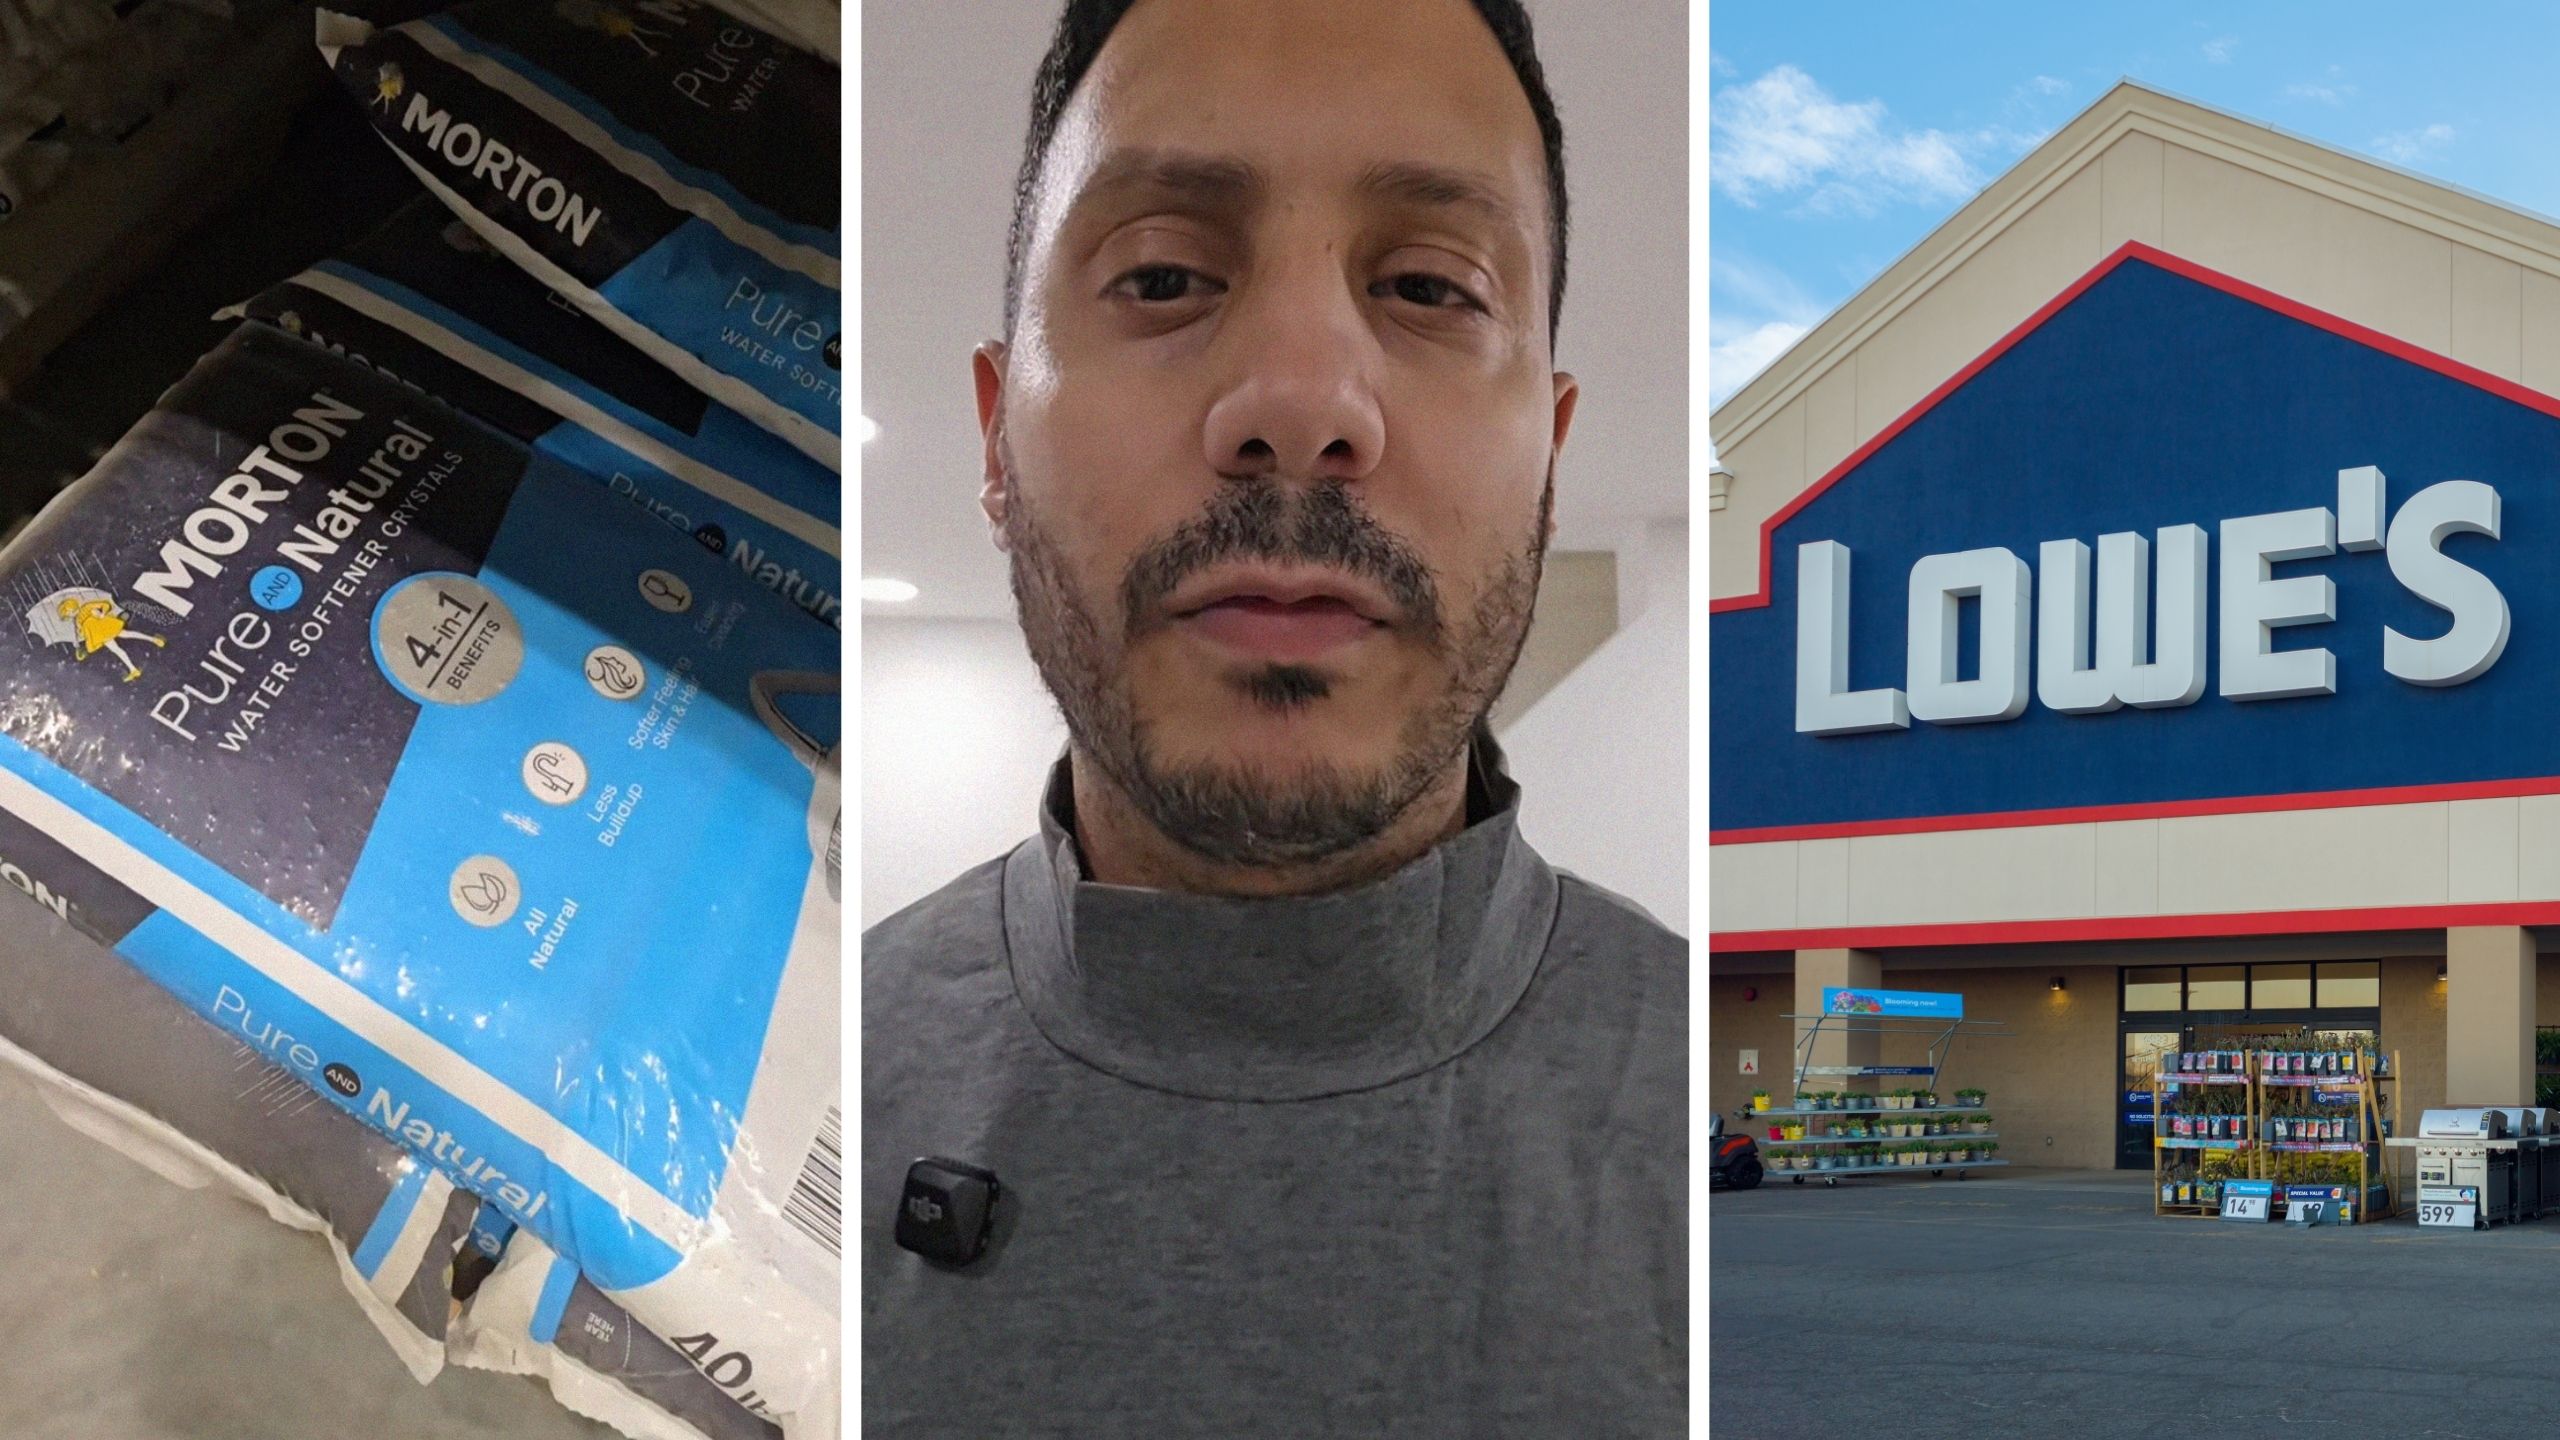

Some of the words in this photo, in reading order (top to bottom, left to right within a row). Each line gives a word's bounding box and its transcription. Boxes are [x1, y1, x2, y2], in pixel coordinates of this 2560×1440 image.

[671, 26, 754, 108] Pure
[731, 57, 781, 112] WATER
[401, 91, 603, 248] MORTON
[724, 276, 822, 351] Pure
[720, 326, 786, 370] WATER
[790, 364, 842, 406] SOFT
[132, 393, 365, 618] MORTON
[276, 418, 434, 573] Natural
[217, 661, 297, 754] WATER
[289, 538, 389, 658] SOFTENER
[381, 449, 464, 538] CRYSTALS
[262, 571, 291, 606] AND
[1795, 465, 2512, 738] LOWE'S
[405, 590, 473, 669] 4-in-1
[446, 619, 501, 690] BENEFITS
[150, 611, 271, 742] Pure
[628, 703, 662, 750] Softer
[654, 657, 693, 706] Feeling
[652, 715, 680, 750] Skin
[671, 704, 687, 717] &
[586, 782, 618, 823] Less
[598, 782, 644, 848] Buildup
[0, 855, 68, 920] ON
[522, 906, 548, 937] All
[529, 897, 579, 971] Natural
[213, 983, 319, 1071] Pure
[326, 1068, 358, 1093] AND
[365, 1087, 547, 1219] Natural
[2230, 1198, 2247, 1215] 14
[2421, 1205, 2455, 1223] 599
[669, 1332, 753, 1389] 40
